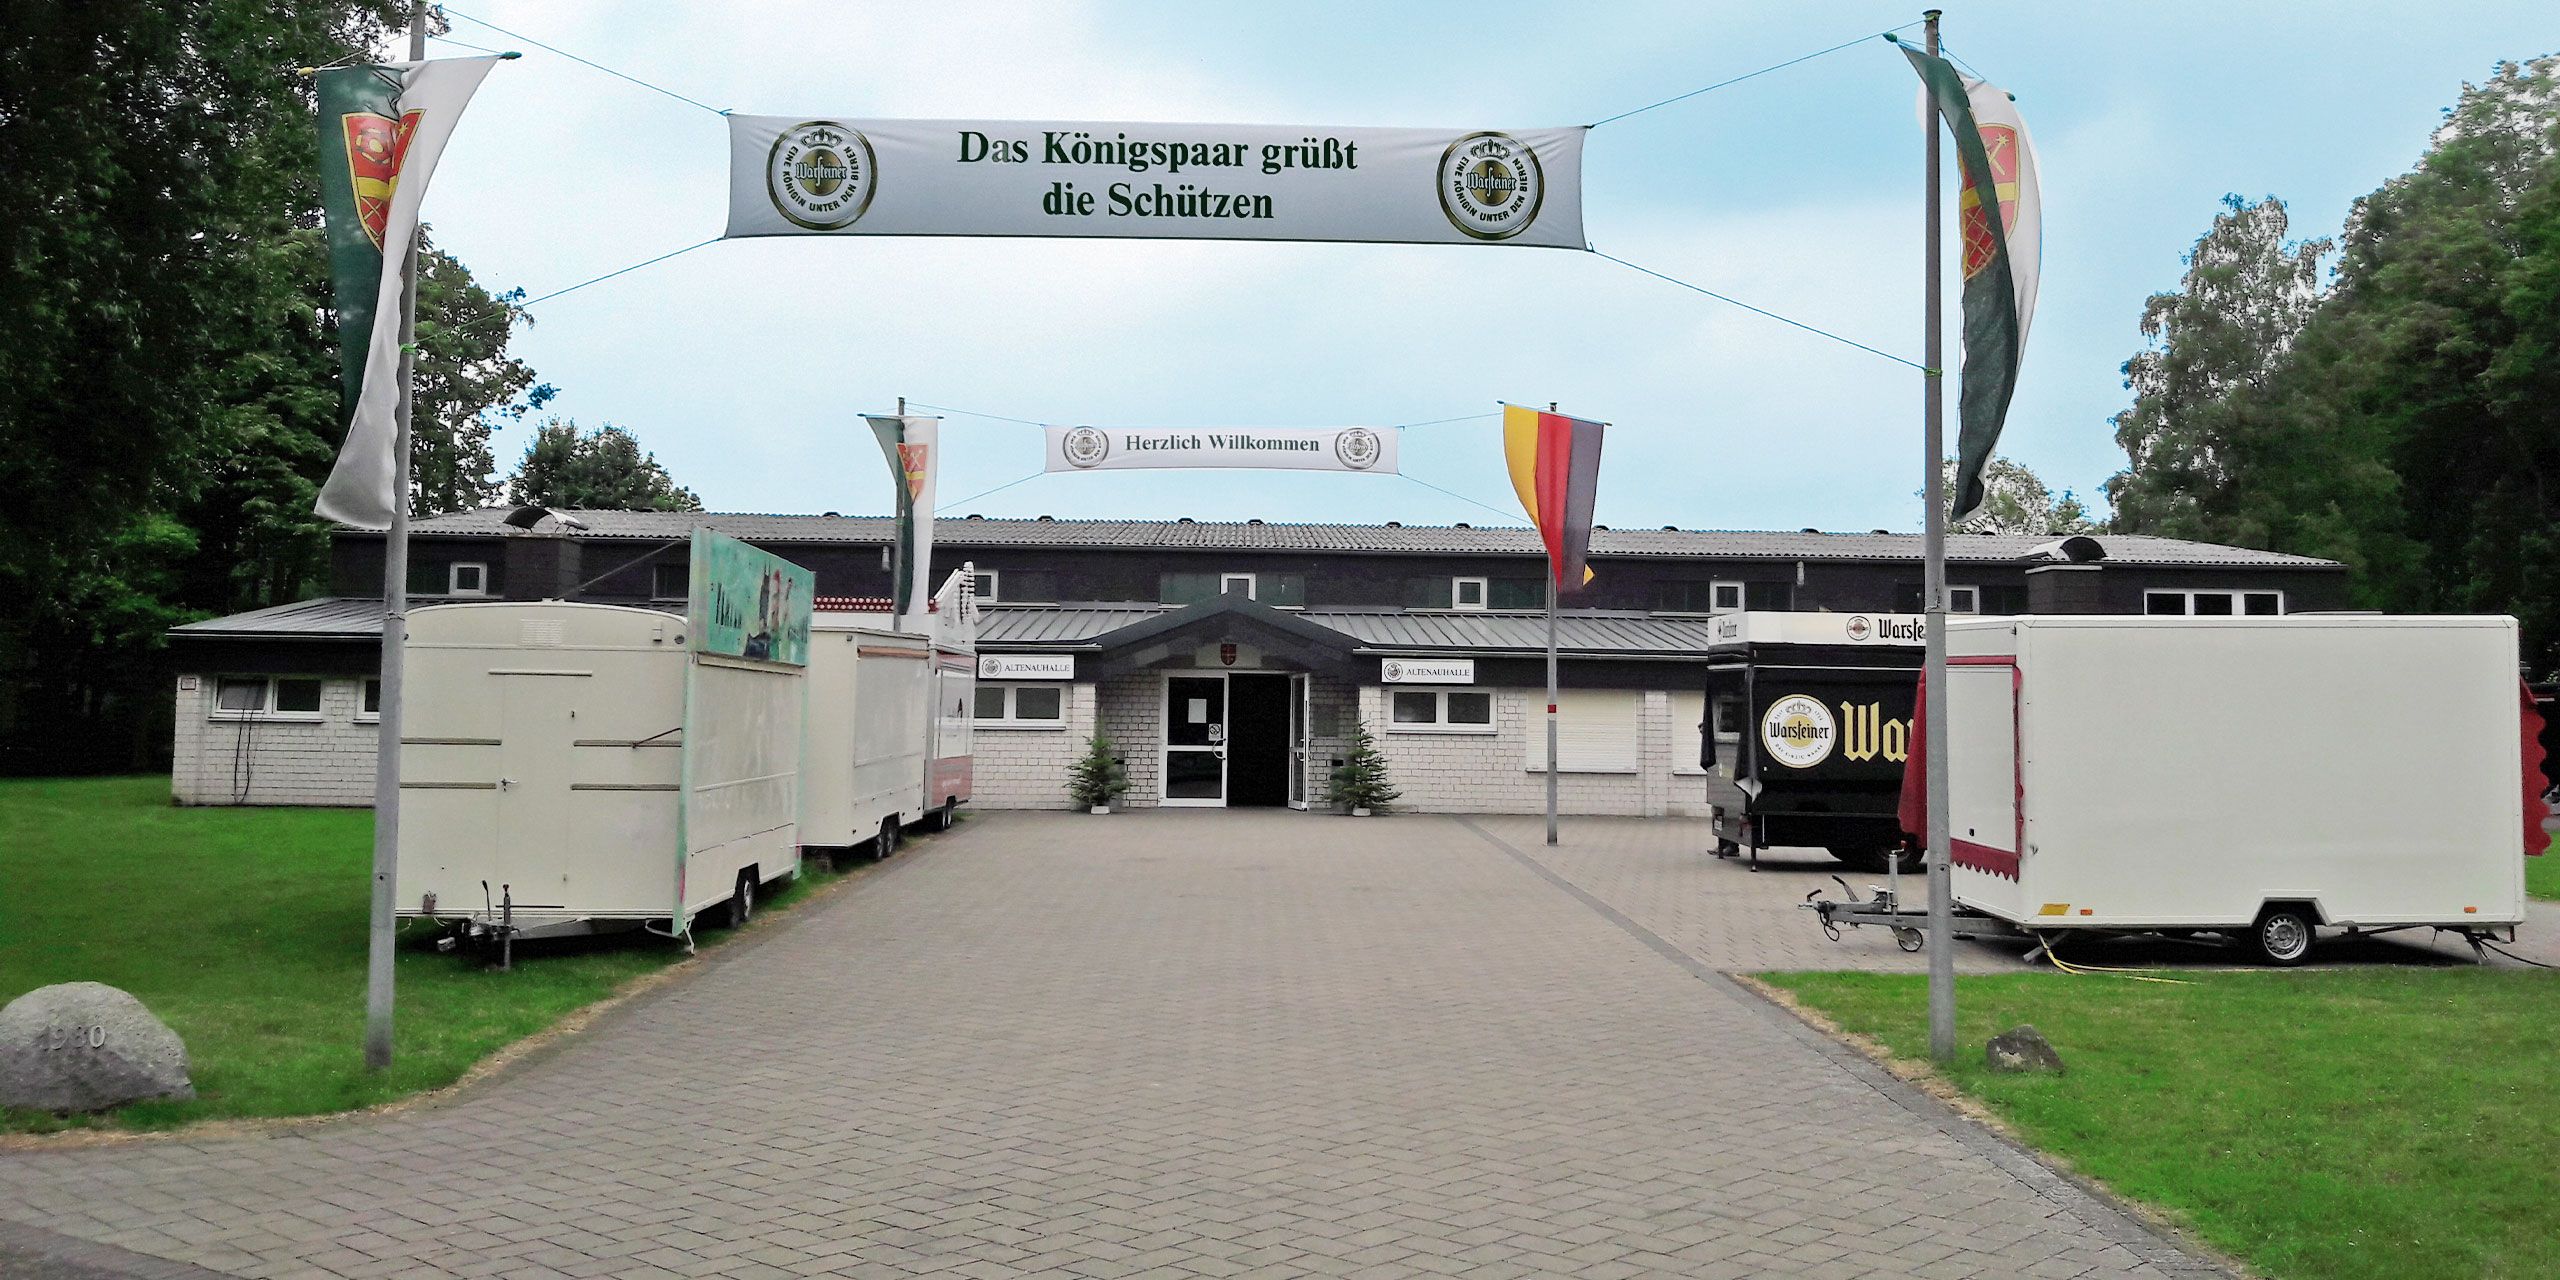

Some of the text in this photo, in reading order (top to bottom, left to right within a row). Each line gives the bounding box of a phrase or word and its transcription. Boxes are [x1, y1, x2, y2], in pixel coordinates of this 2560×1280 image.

[956, 130, 1359, 175] Das Königspaar grüßt
[782, 145, 859, 212] EINE KÖNIGIN UNTER DEN BIEREN
[1453, 156, 1528, 222] EINE KÖNIGIN UNTER DEN BIEREN
[1042, 181, 1275, 219] die Schützen
[1125, 434, 1320, 452] Herzlich Willkommen
[1878, 617, 1926, 641] Warste
[1004, 664, 1070, 672] ALTENAUHALLE
[1406, 668, 1470, 677] ALTENAUHALLE
[1769, 720, 1829, 740] Warsteiner
[1840, 700, 1913, 763] Wa
